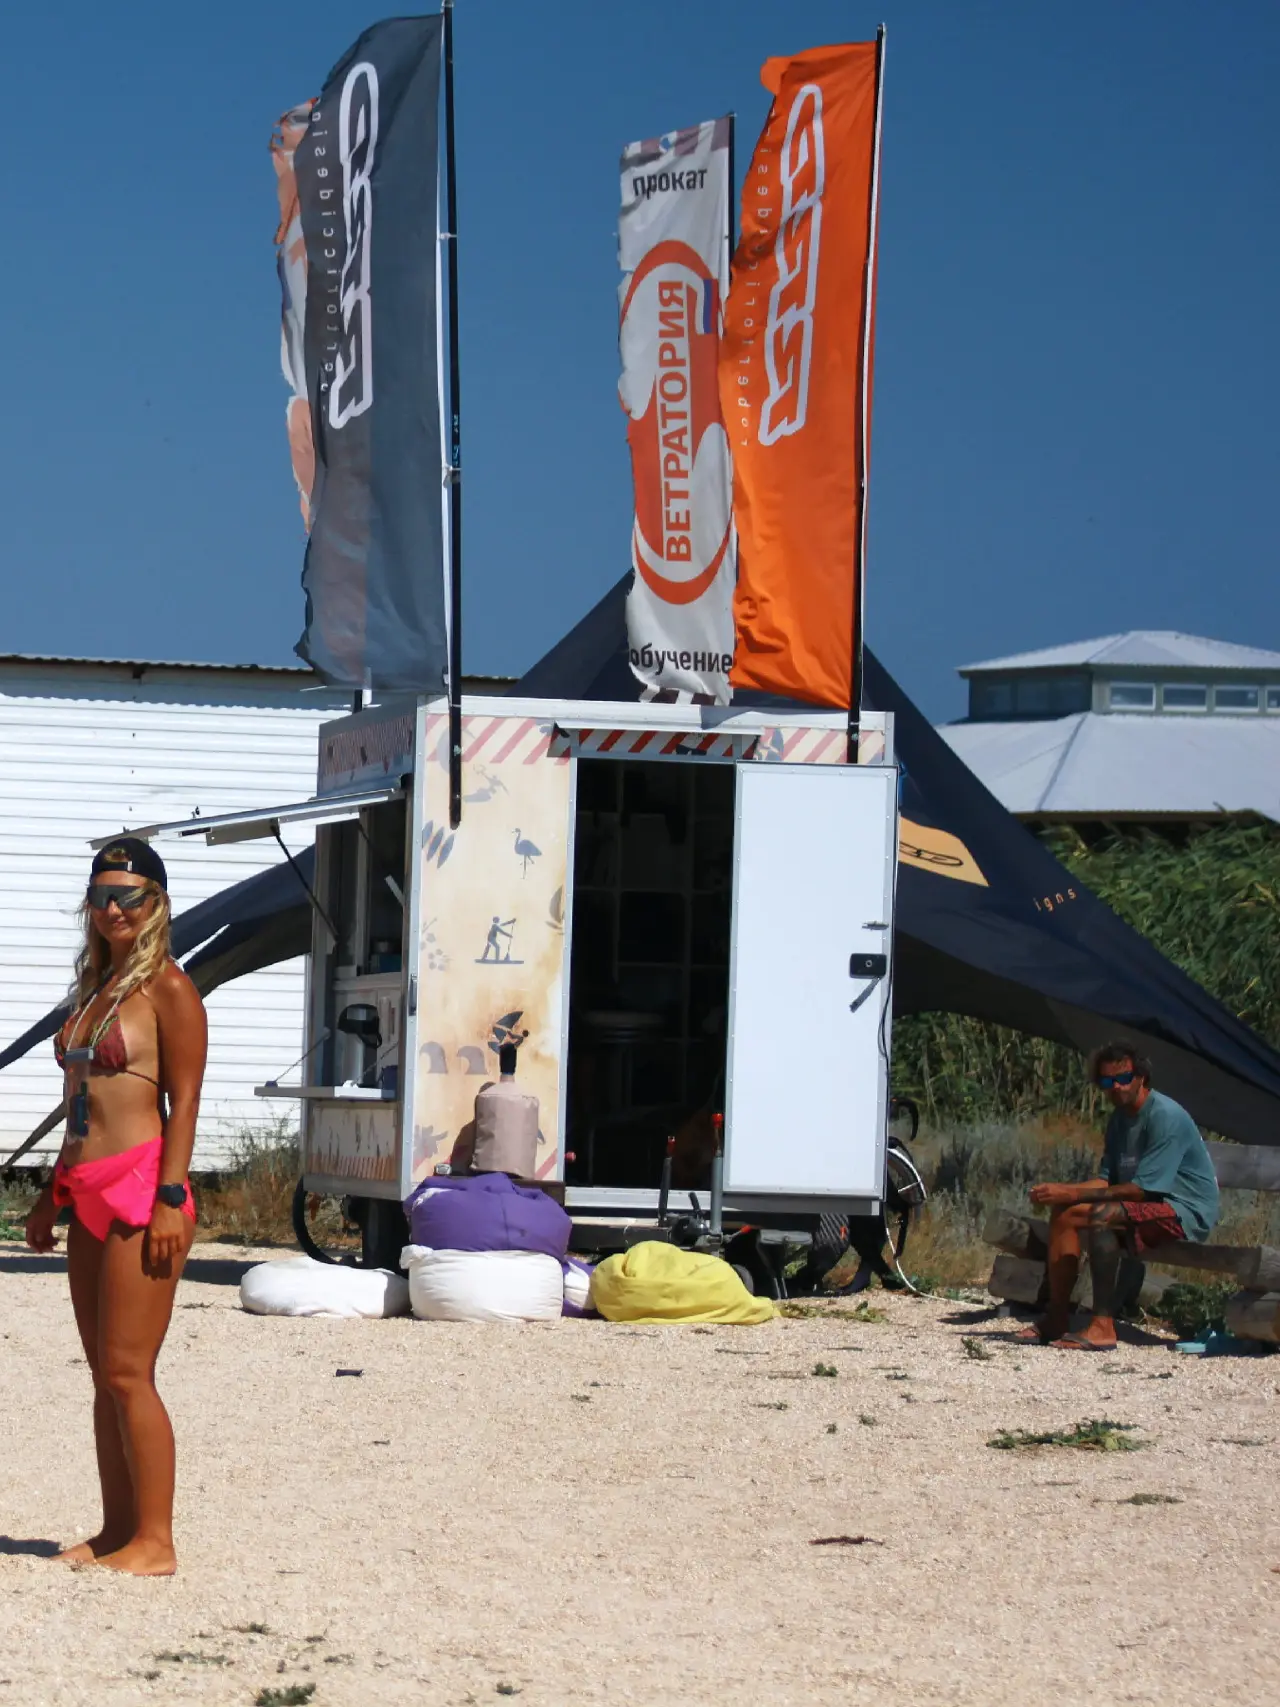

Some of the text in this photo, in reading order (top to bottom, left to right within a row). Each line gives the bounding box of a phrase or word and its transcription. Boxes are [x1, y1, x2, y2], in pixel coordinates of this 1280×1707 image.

[632, 168, 707, 200] прокат
[658, 281, 692, 562] ВЕТРАТОРИЯ
[630, 642, 733, 676] обучение
